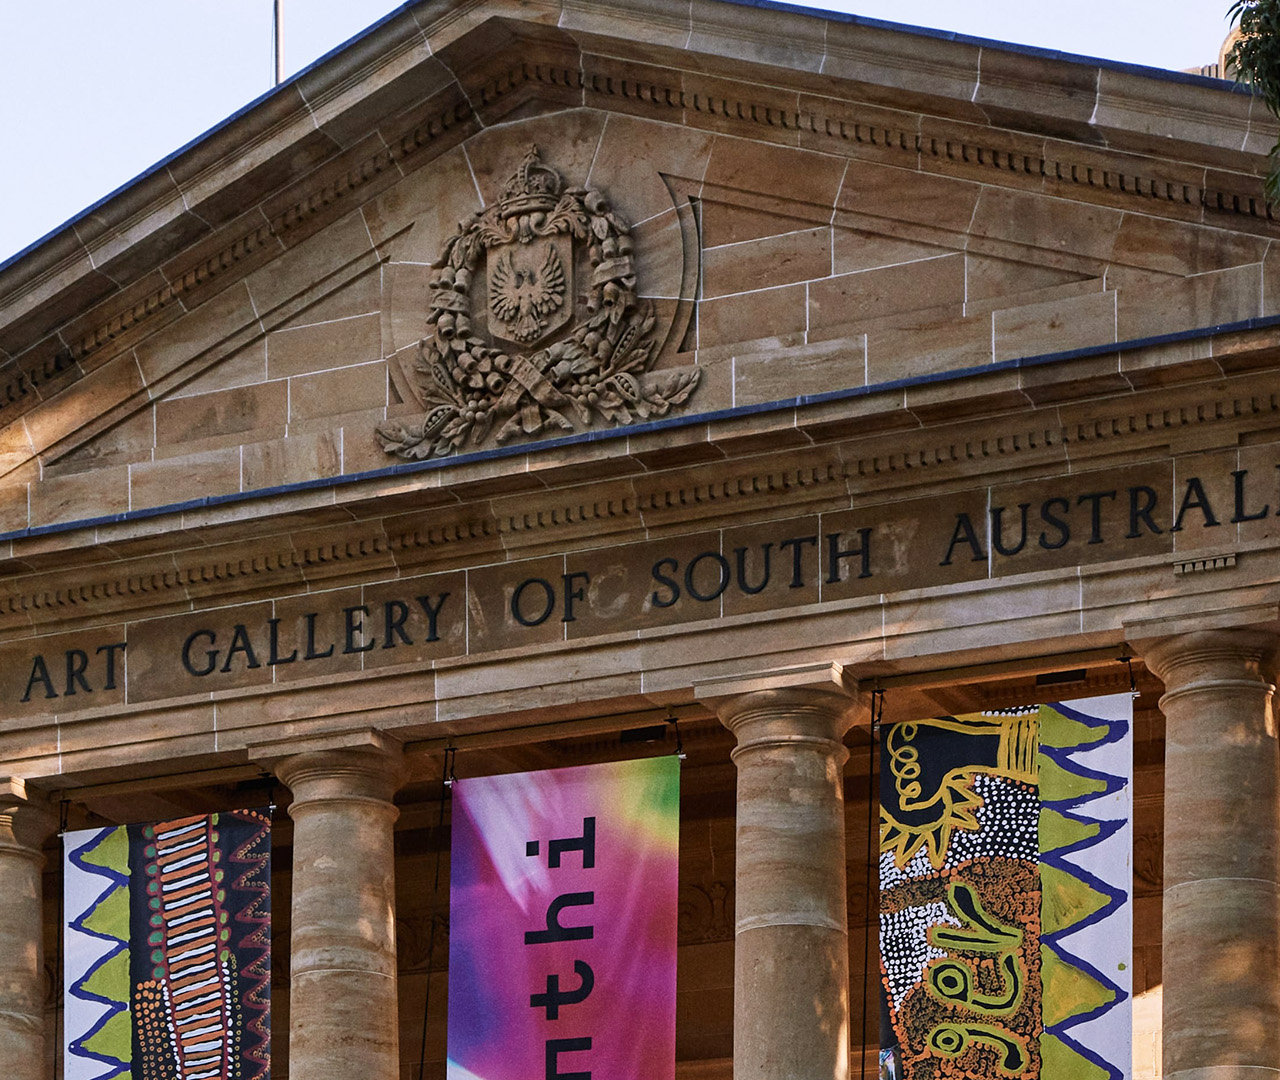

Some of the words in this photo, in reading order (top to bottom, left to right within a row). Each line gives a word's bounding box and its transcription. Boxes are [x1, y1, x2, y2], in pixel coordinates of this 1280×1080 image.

[21, 643, 126, 703] ART
[182, 593, 450, 677] GALLERY
[510, 571, 590, 628] OF
[652, 528, 872, 608] SOUTH
